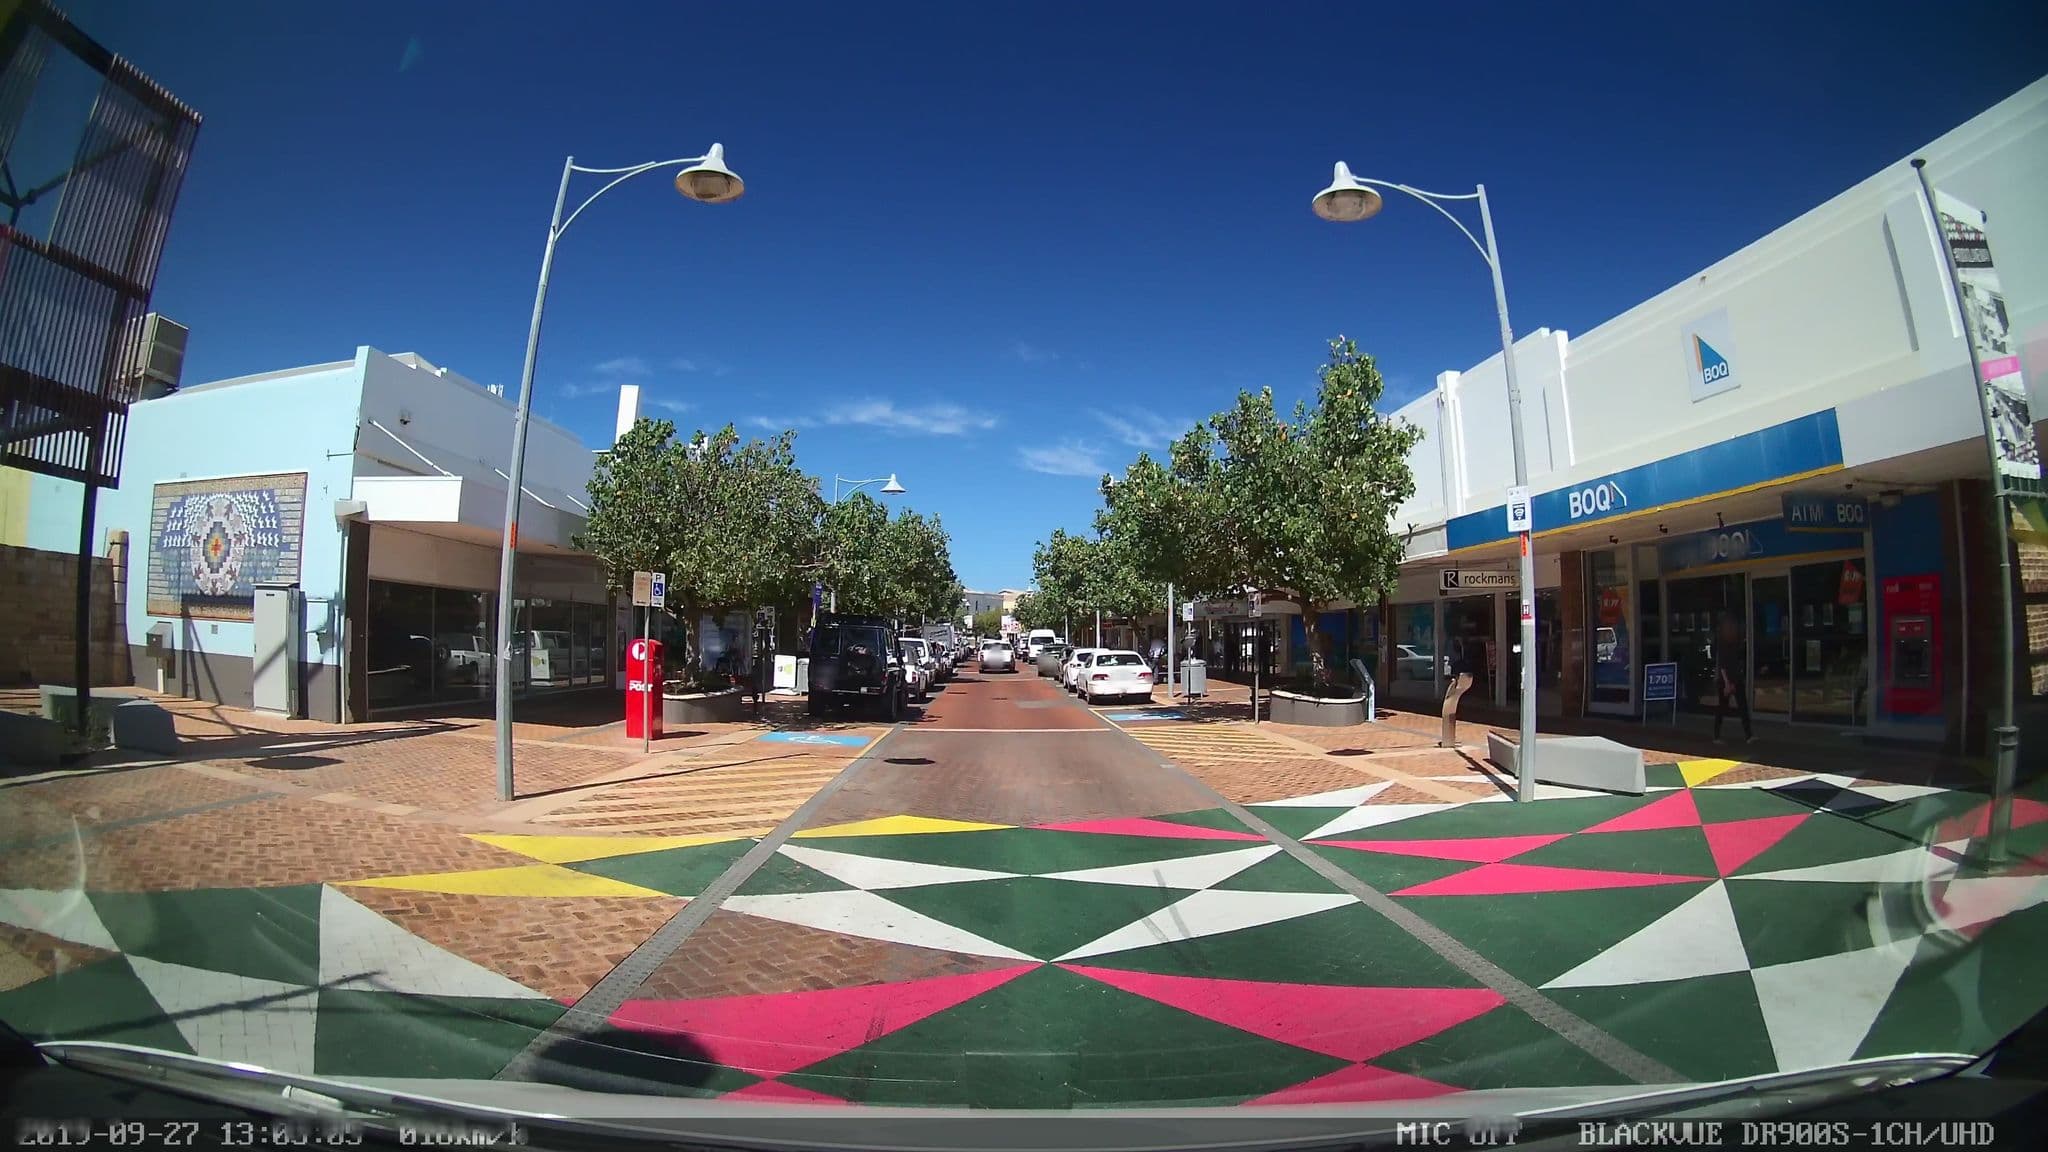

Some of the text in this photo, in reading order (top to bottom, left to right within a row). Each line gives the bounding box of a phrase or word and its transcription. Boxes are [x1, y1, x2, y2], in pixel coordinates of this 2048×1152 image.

[1704, 362, 1728, 382] BOQ
[1569, 484, 1610, 519] BOQ
[1792, 503, 1823, 522] ATM
[1464, 574, 1515, 586] rockmans
